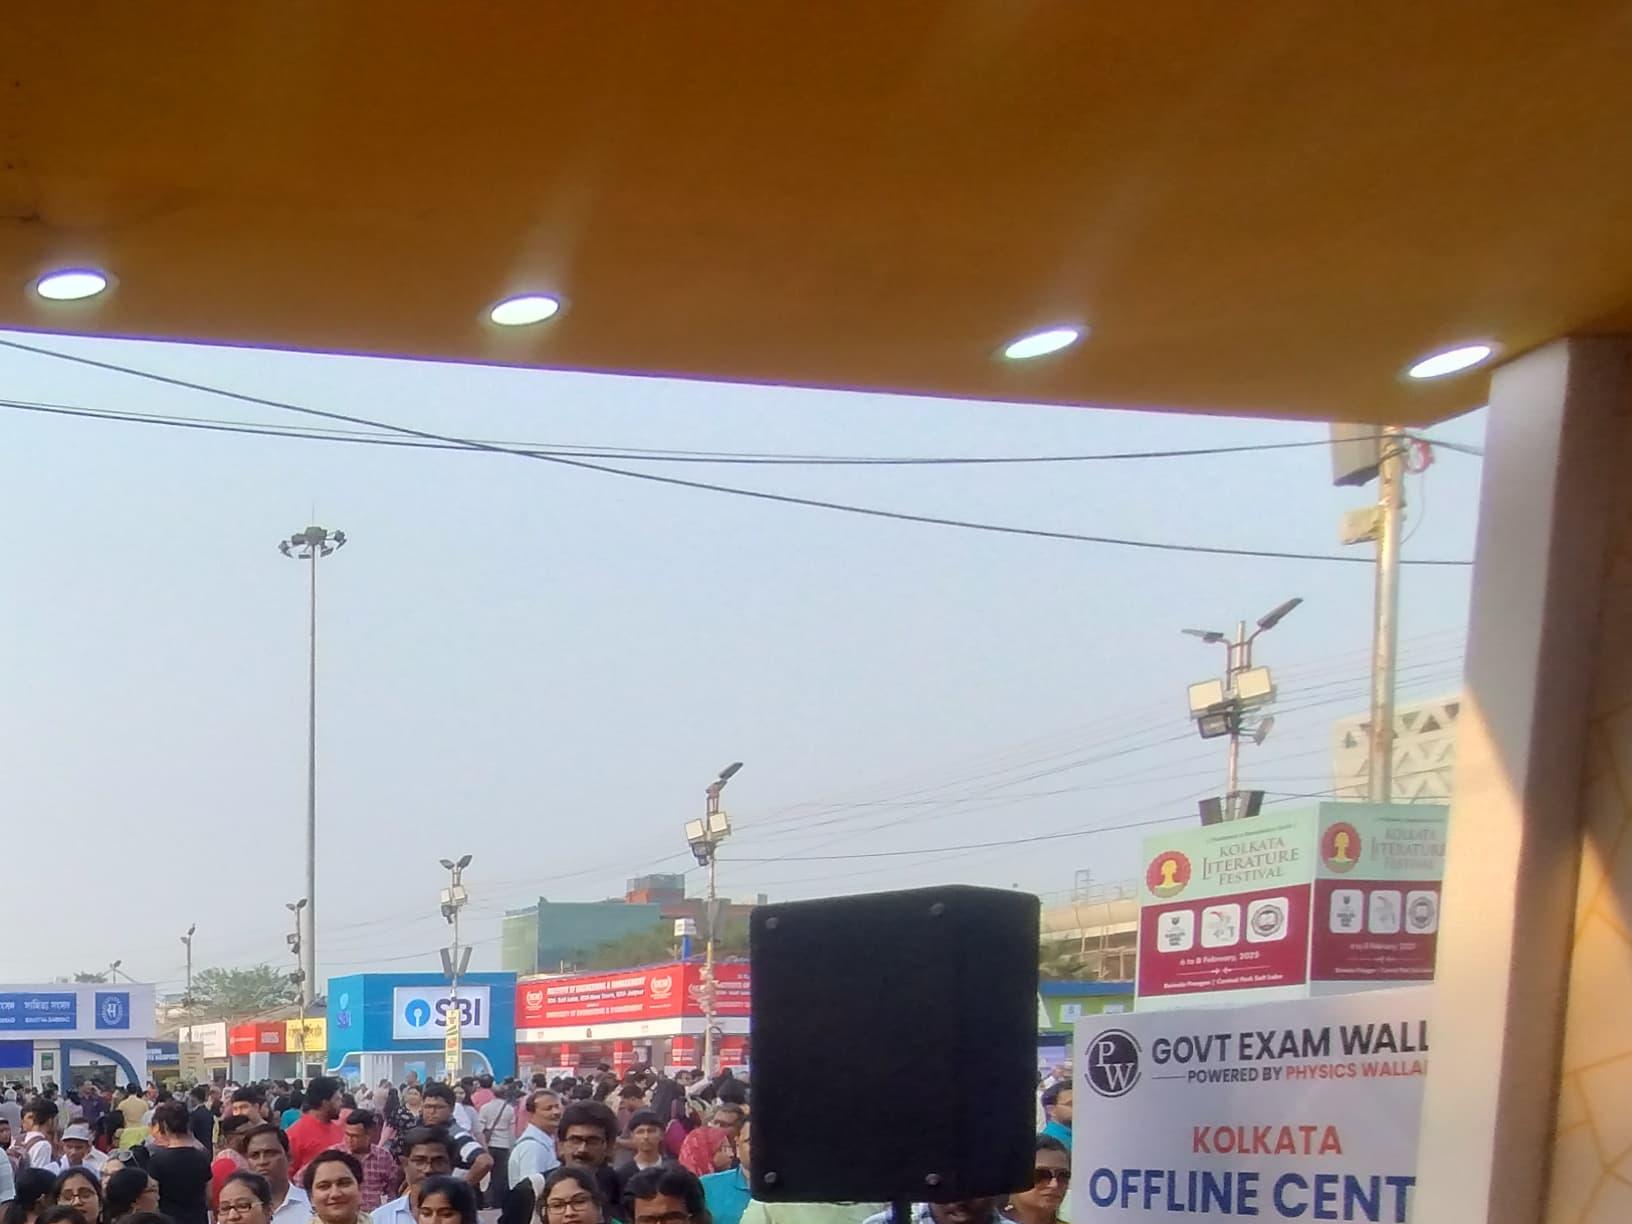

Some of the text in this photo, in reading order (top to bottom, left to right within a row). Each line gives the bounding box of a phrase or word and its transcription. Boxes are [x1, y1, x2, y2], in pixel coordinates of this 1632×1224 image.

[1219, 836, 1285, 857] KOLKATA
[1202, 848, 1300, 880] LITERATURE
[1219, 866, 1285, 886] FESTIVAL
[435, 998, 480, 1027] SBI
[1152, 1033, 1232, 1065] GOVT
[1238, 1027, 1331, 1061] EXAM
[1187, 1060, 1428, 1084] POWERED BY PHYSICS WALLA
[1193, 1125, 1343, 1155] KOLKATA
[1089, 1167, 1416, 1224] OFFLINE CENT
